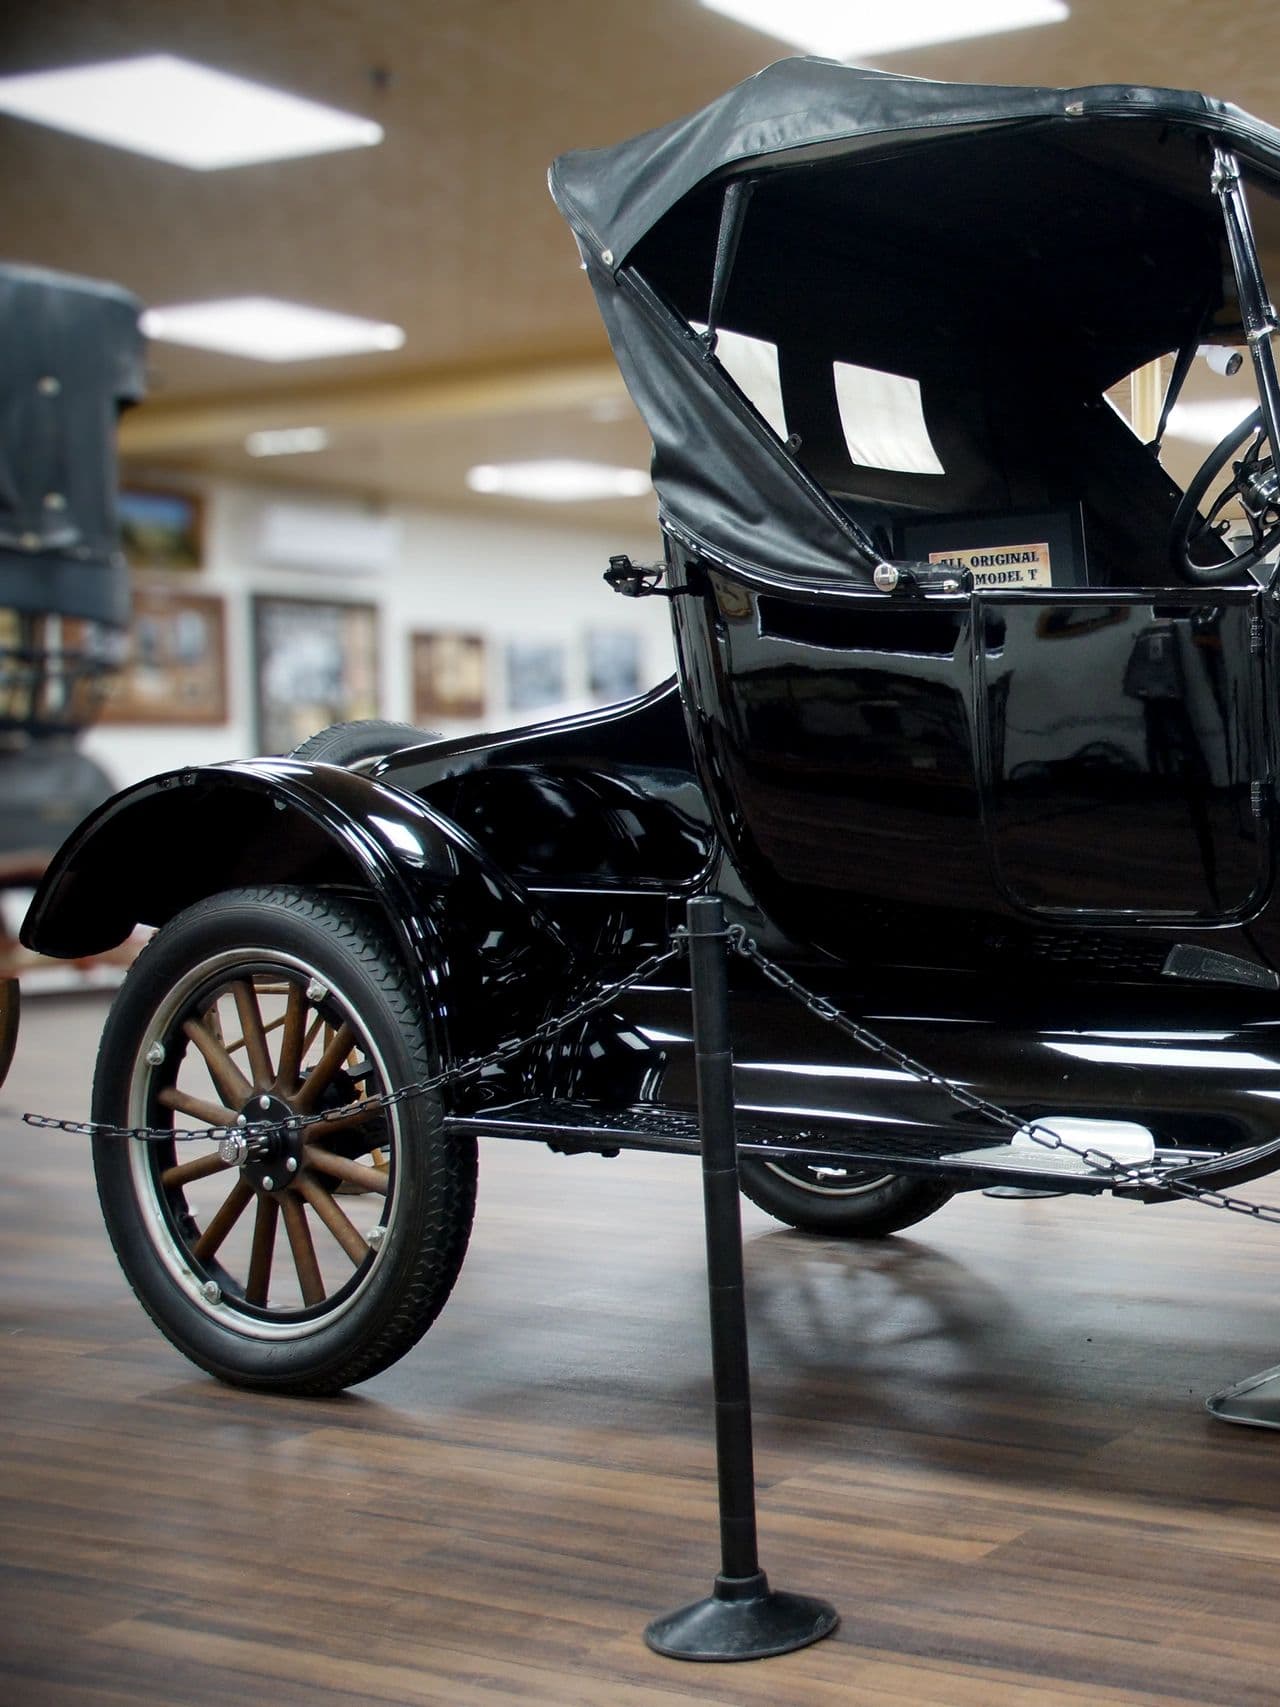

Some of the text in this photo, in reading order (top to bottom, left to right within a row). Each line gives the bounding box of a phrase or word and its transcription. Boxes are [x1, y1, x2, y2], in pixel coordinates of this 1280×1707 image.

[970, 552, 1039, 567] ORIGINAL
[975, 569, 1037, 585] MODEL T
